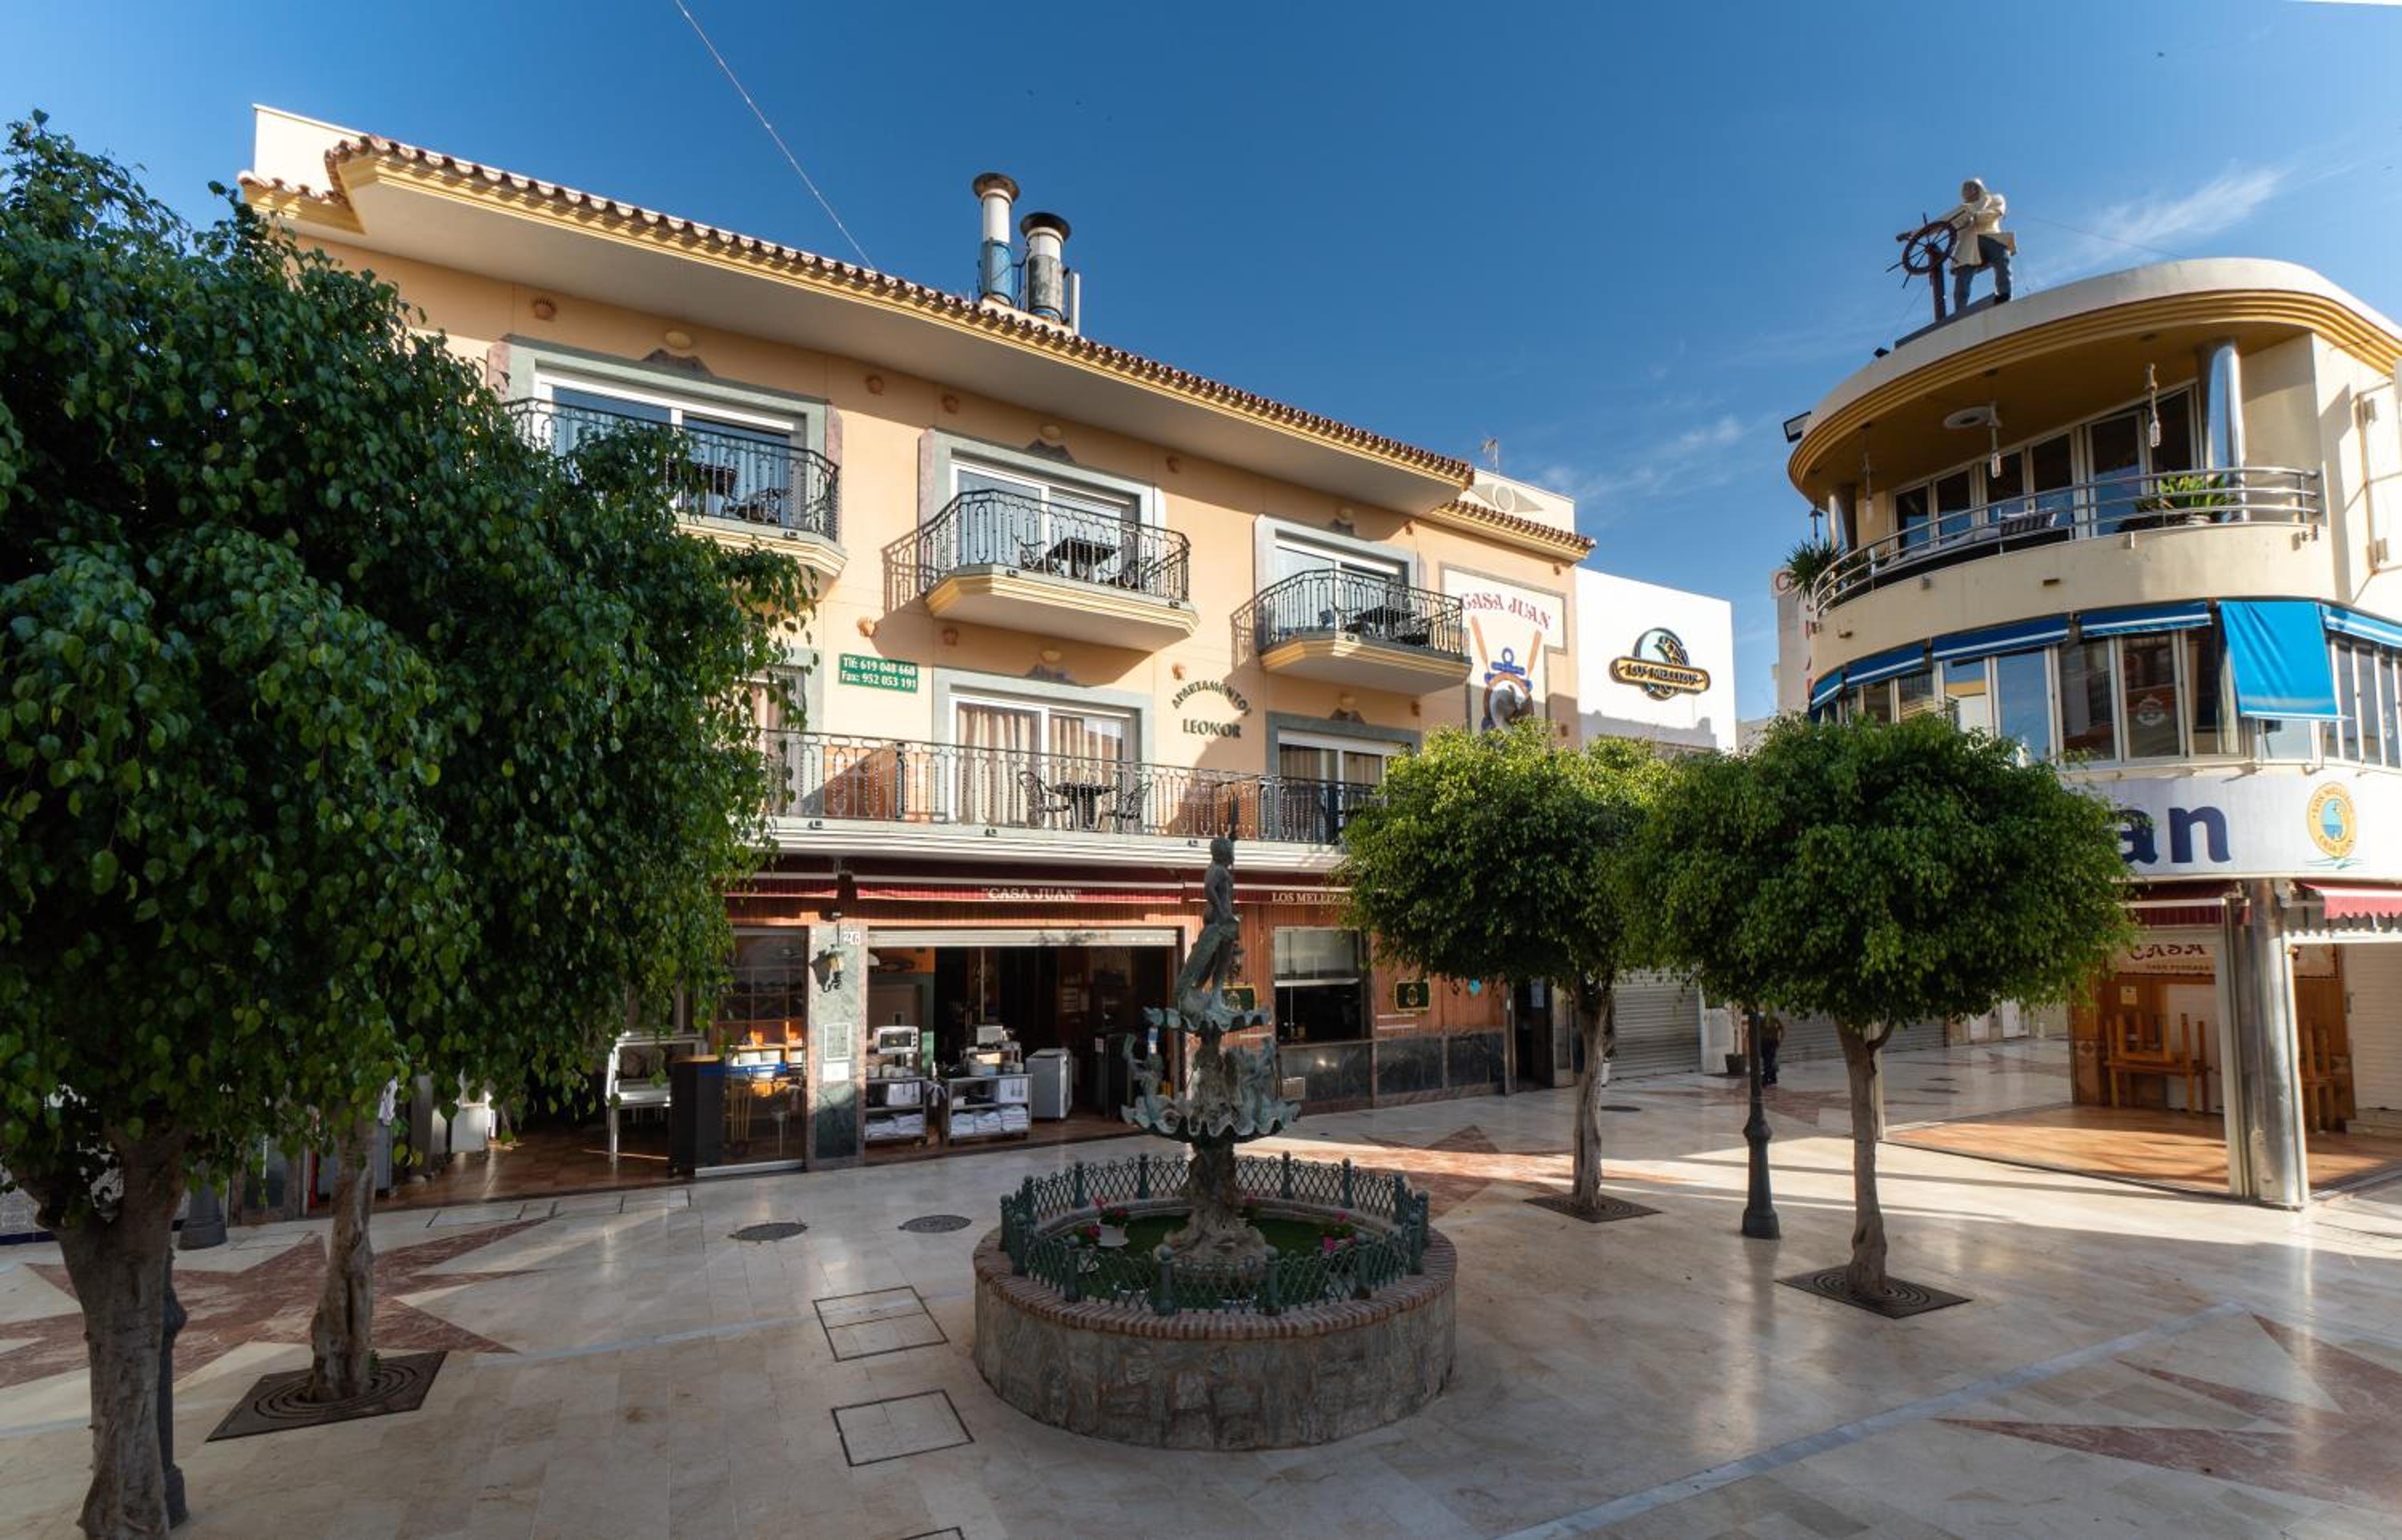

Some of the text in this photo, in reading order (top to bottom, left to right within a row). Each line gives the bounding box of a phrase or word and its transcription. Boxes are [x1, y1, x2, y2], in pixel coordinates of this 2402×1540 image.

[1460, 592, 1551, 630] CASA JUAN
[860, 660, 878, 672] 619
[862, 672, 879, 684] 952
[1183, 718, 1242, 739] LEONOR
[1271, 892, 1295, 902] LOS
[845, 932, 860, 944] 26
